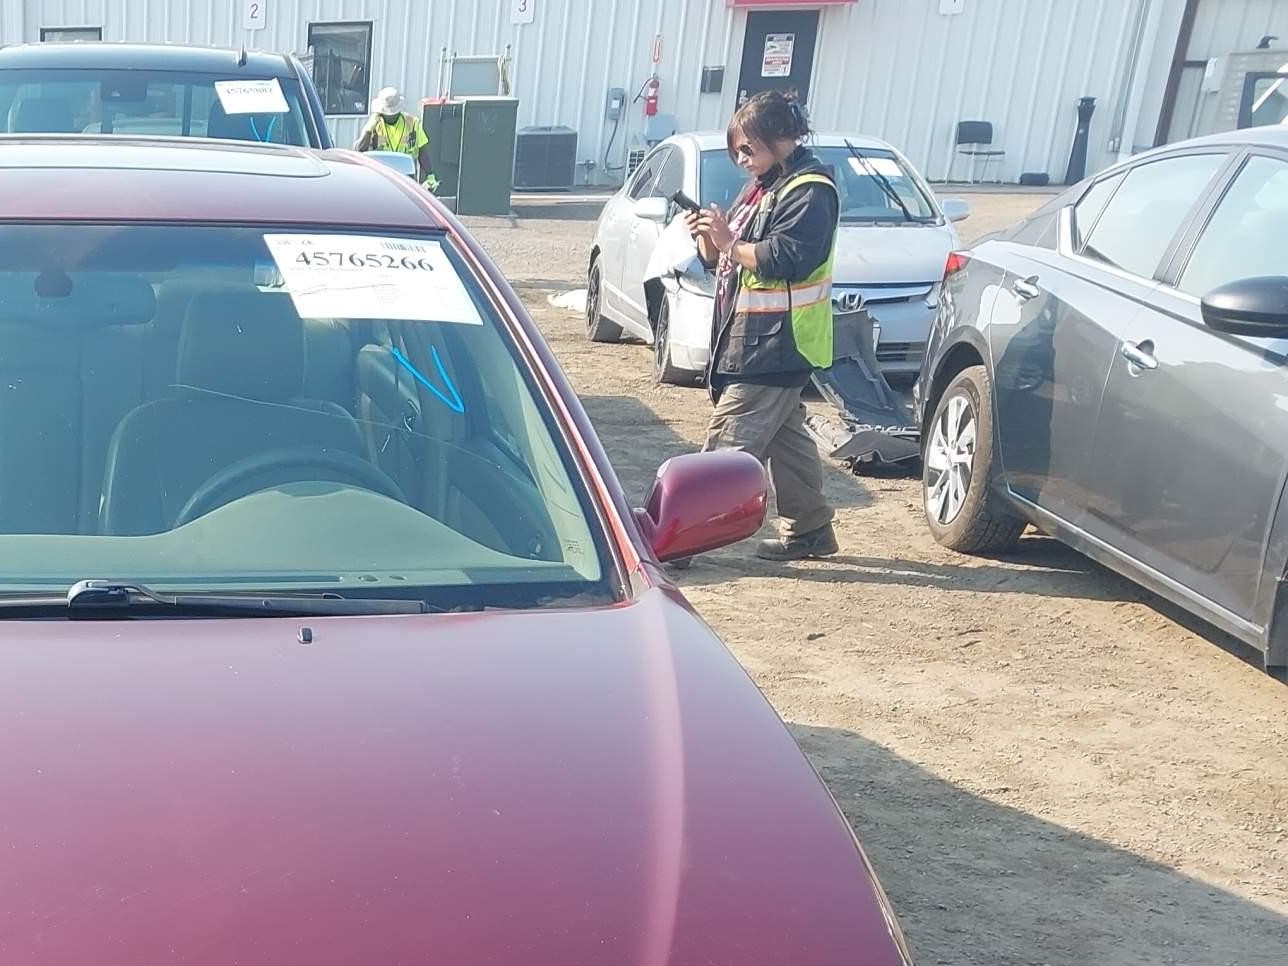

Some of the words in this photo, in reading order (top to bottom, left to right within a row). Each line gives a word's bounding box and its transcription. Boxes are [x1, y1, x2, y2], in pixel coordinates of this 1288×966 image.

[250, 3, 258, 19] 2
[518, 0, 527, 12] 3
[295, 251, 434, 272] 45765266
